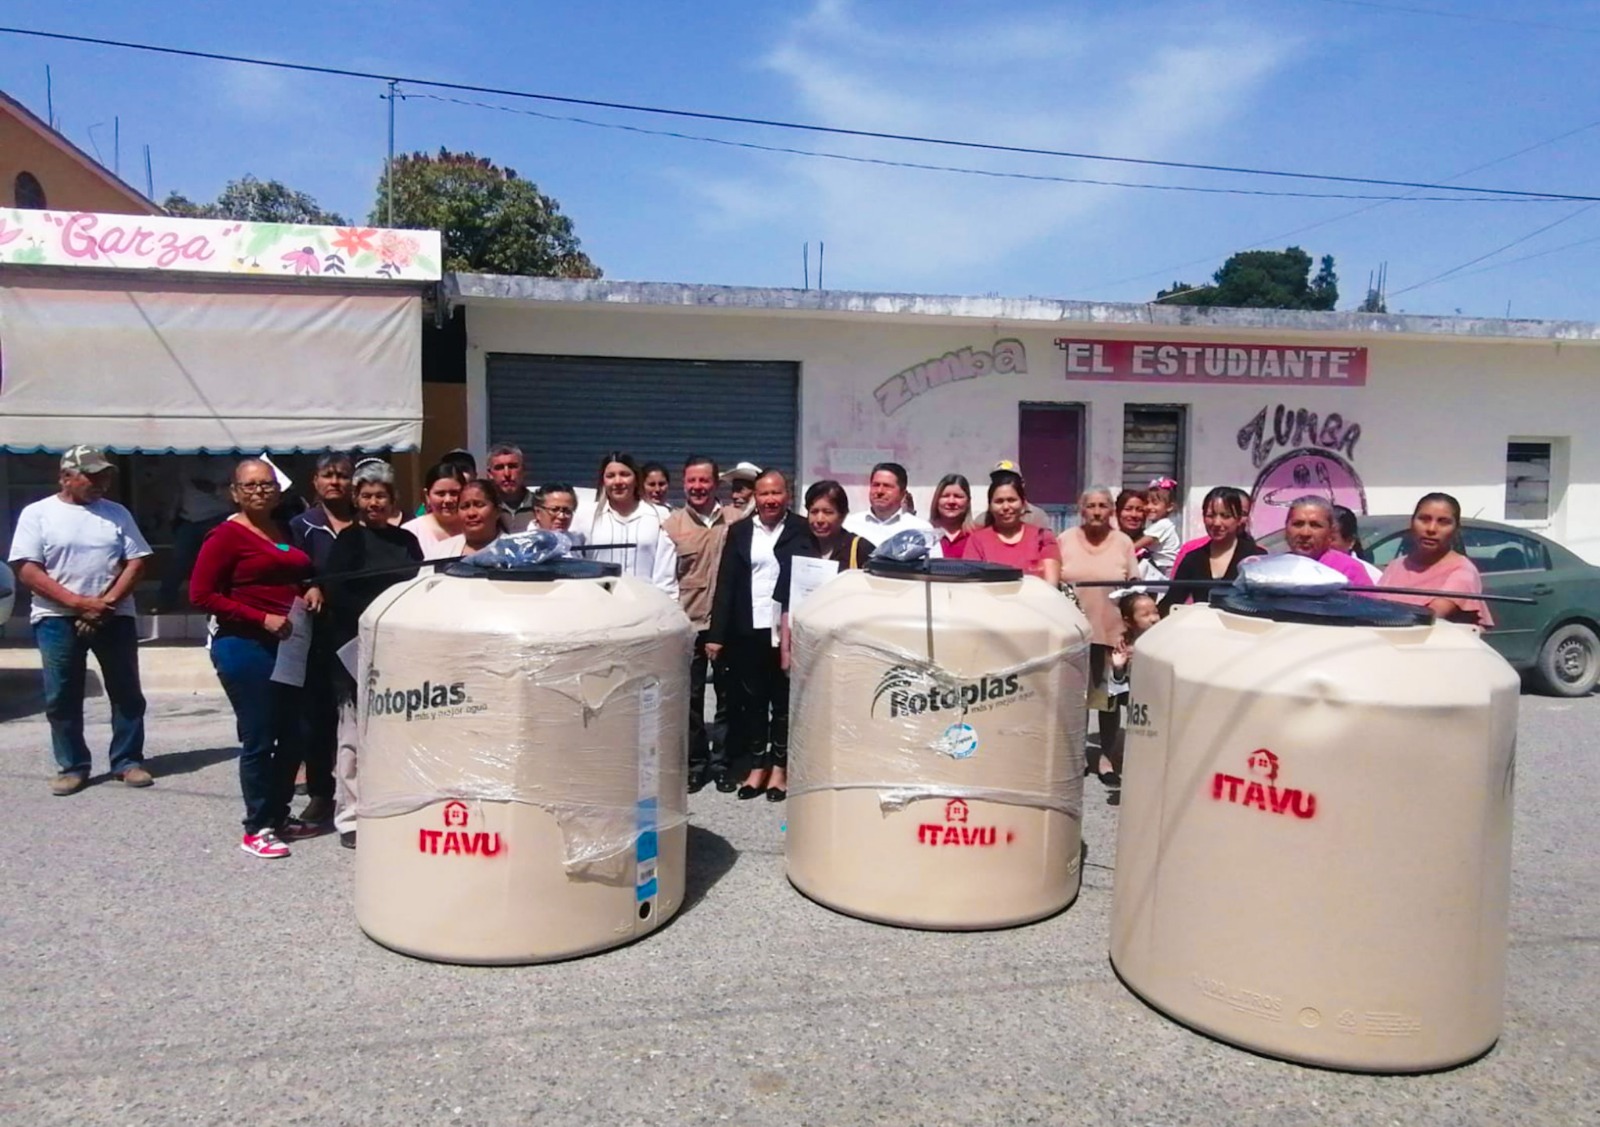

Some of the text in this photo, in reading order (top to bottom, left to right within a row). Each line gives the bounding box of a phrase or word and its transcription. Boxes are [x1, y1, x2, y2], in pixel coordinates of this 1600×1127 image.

[1236, 403, 1361, 469] ZUMBA
[368, 680, 466, 721] Rotoplas
[890, 674, 1018, 717] Rotoplas
[1211, 772, 1318, 819] ITAVU
[419, 829, 502, 857] ITAVU
[919, 824, 996, 846] ITAVU
